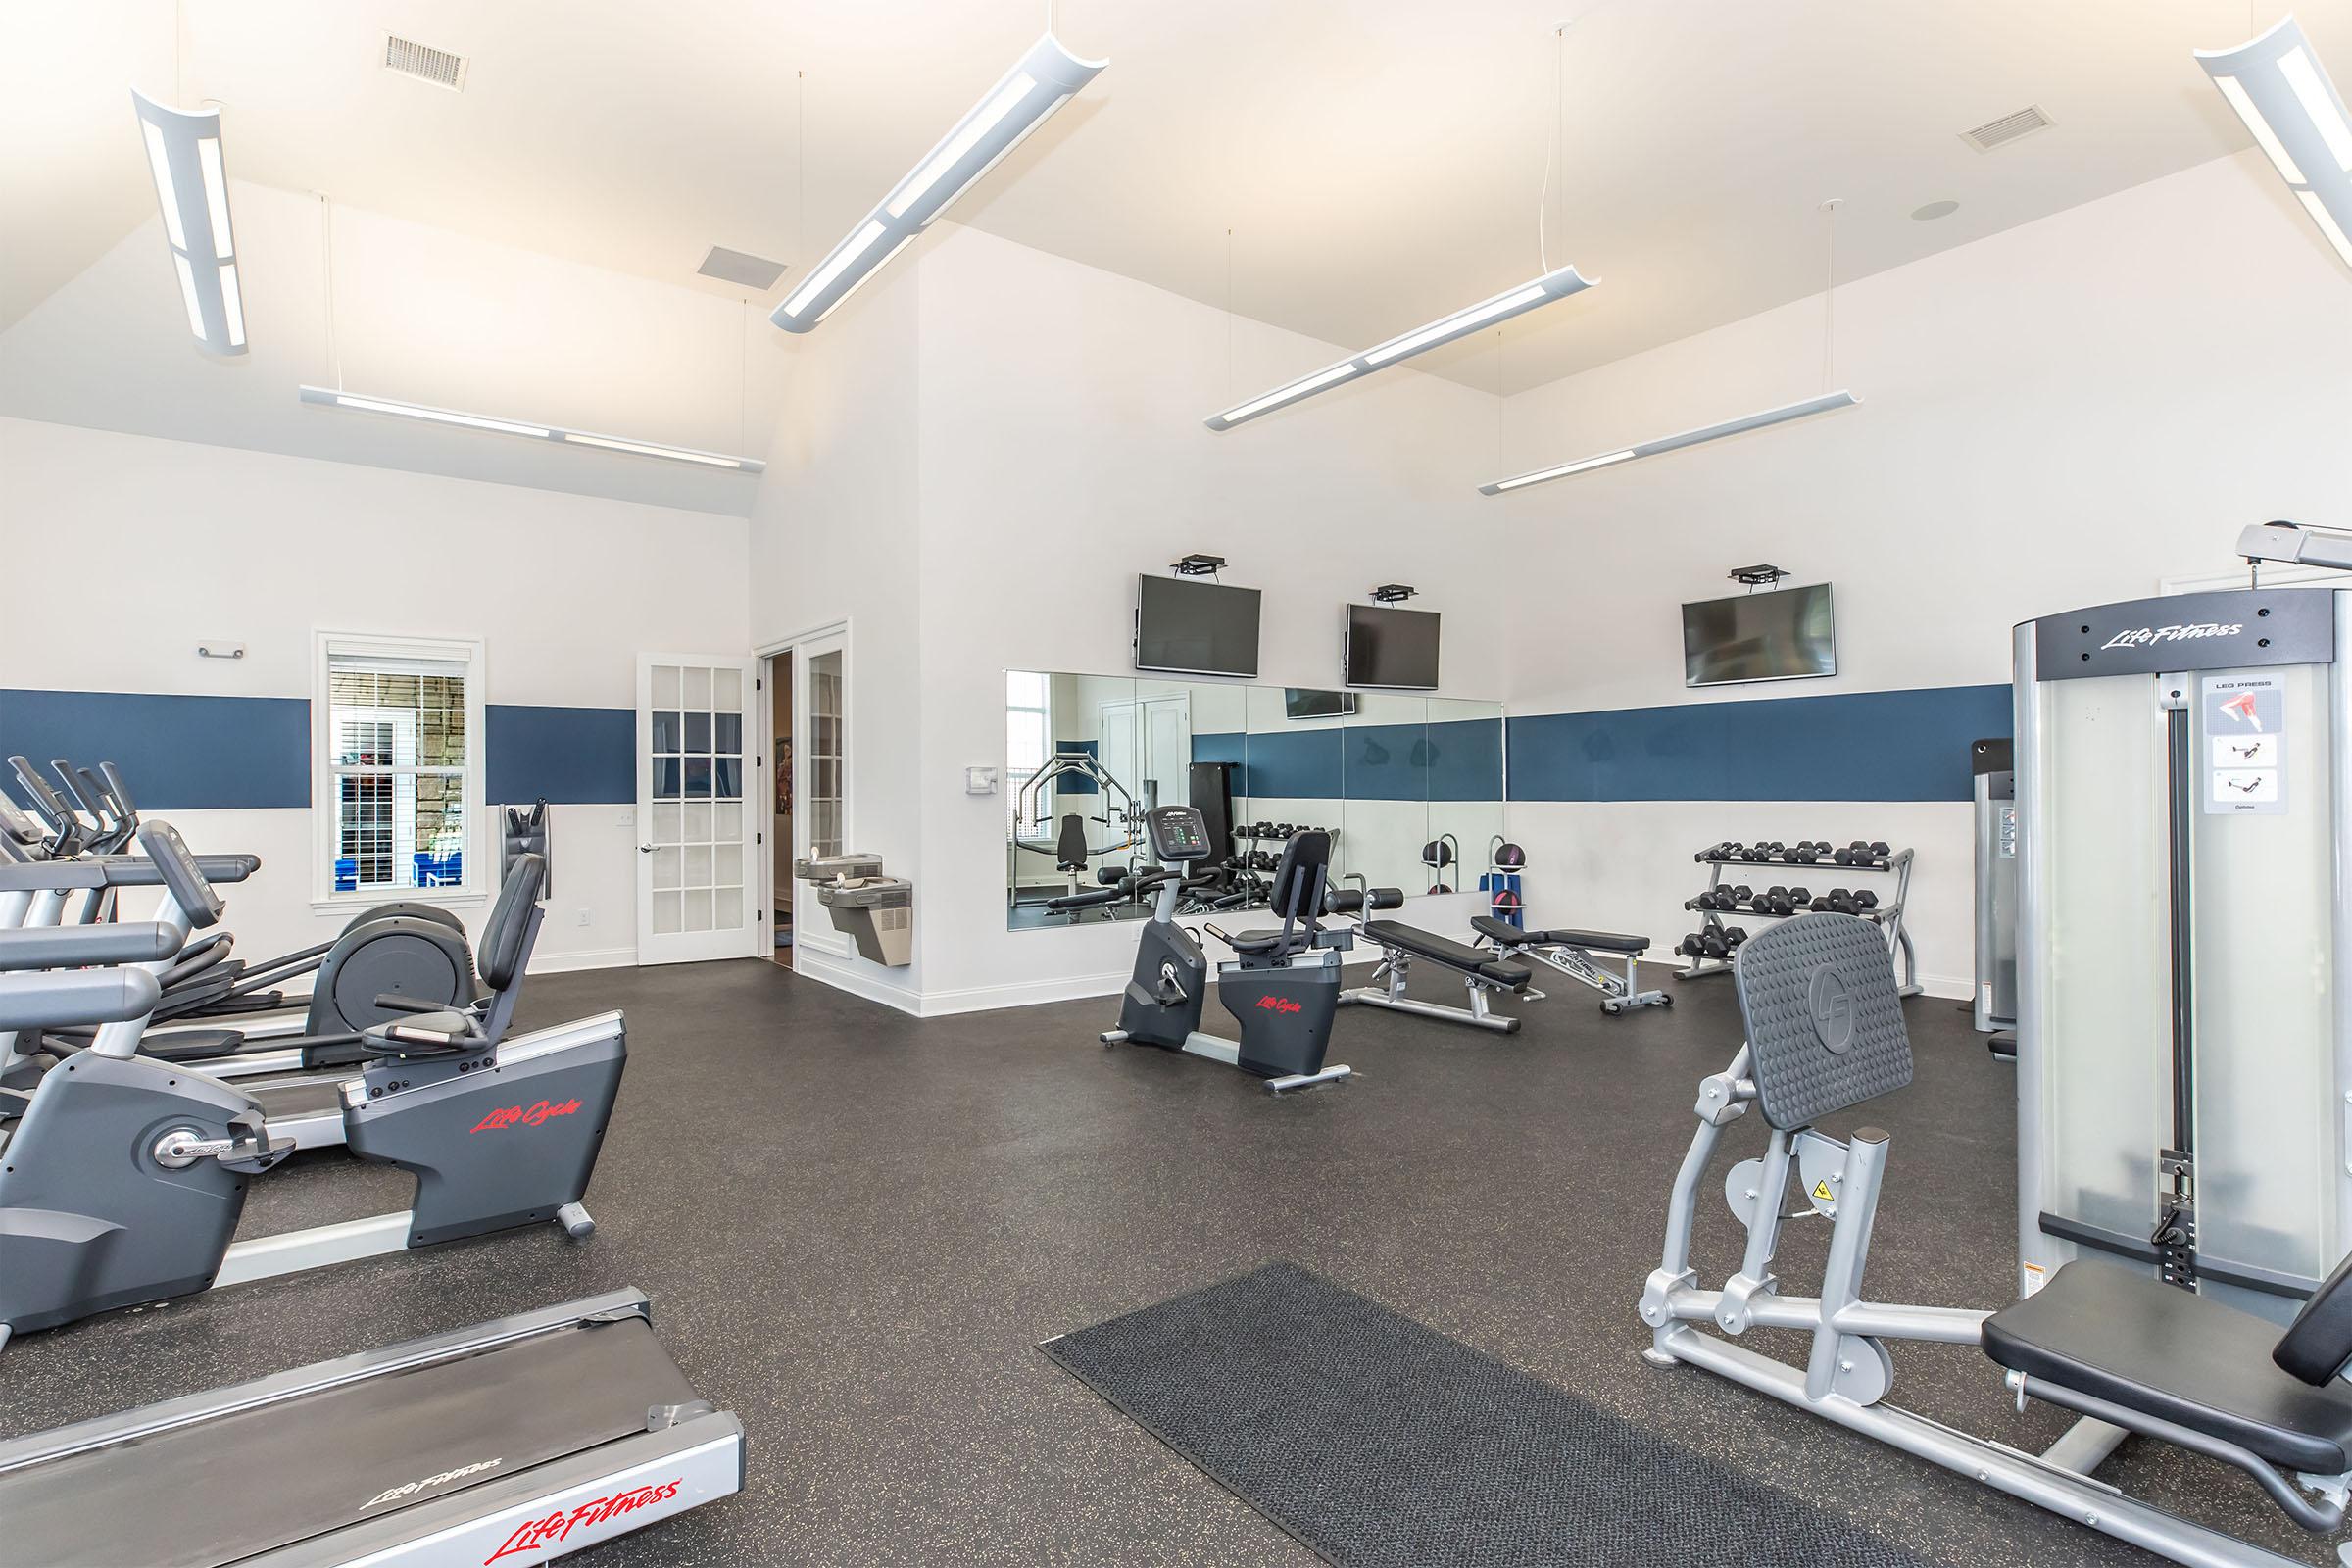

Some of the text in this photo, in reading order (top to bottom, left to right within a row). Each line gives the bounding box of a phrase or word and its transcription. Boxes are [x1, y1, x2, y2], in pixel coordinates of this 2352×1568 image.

[1254, 995, 1278, 1011] Life
[469, 1098, 583, 1134] Life Cycle
[483, 1477, 683, 1567] Life Fitness
